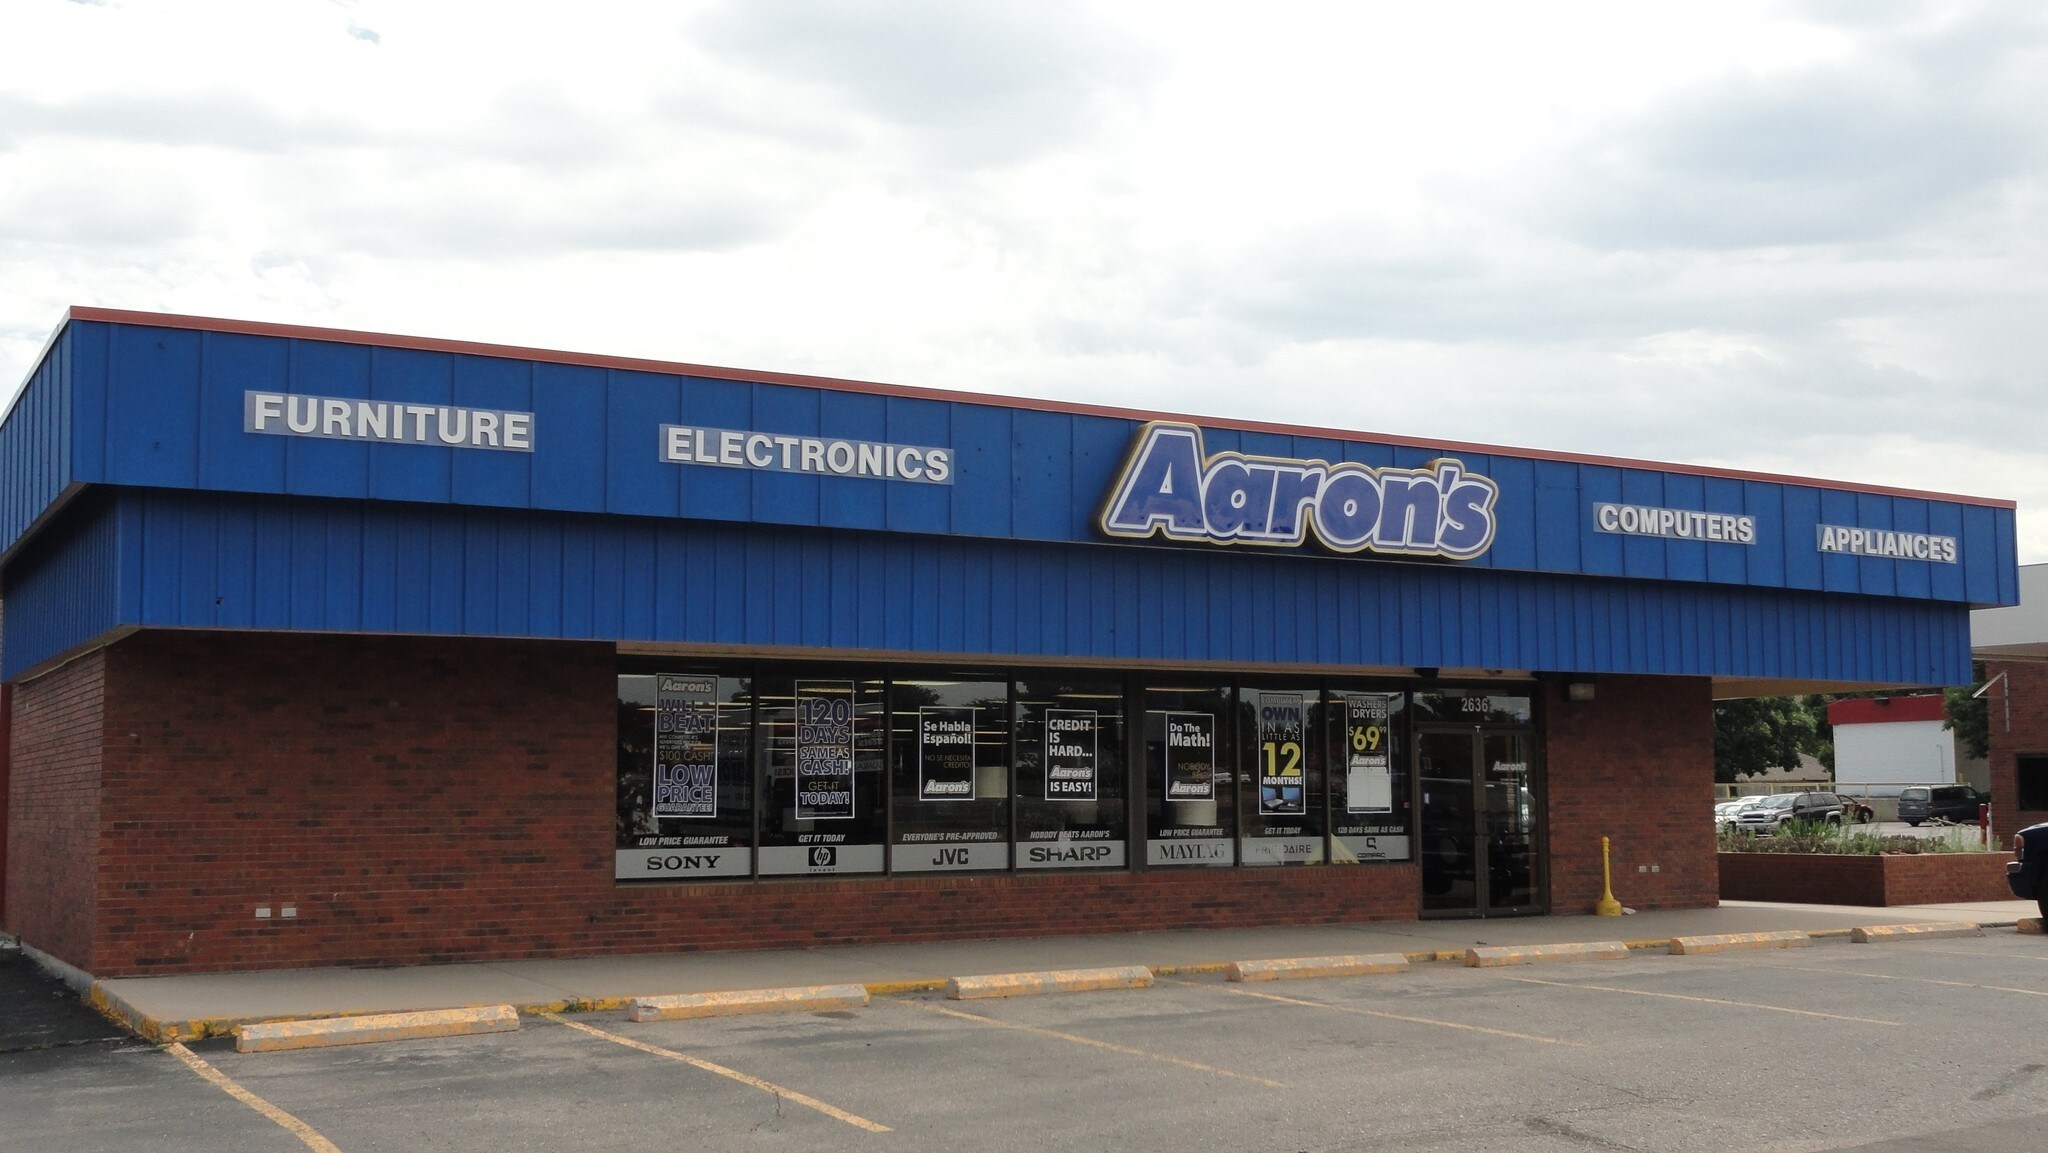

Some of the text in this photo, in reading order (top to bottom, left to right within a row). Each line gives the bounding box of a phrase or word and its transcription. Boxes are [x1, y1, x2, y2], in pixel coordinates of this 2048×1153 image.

[254, 394, 531, 449] FURNITURE
[667, 428, 949, 482] ELECTRONICS
[1107, 427, 1495, 555] Aaron's
[1599, 505, 1754, 542] COMPUTERS
[1820, 527, 1956, 561] APPLIANCES
[661, 679, 713, 693] Aaron's
[1348, 700, 1387, 709] WASHERS
[1461, 697, 1489, 712] 2636
[800, 698, 851, 727] 120
[1261, 706, 1300, 720] OWN
[1352, 709, 1387, 718] DRYERS
[659, 712, 715, 733] BEAT
[923, 721, 971, 732] Se Habla
[1049, 719, 1091, 731] CREDIT
[1169, 723, 1200, 732] Do The
[1261, 722, 1300, 733] IN AS
[800, 726, 850, 744] DAYS
[1049, 732, 1060, 743] IS
[1169, 733, 1211, 747] Math!
[660, 751, 681, 760] $100
[800, 746, 850, 759] SAME AS
[1049, 745, 1093, 757] HARD...
[1262, 742, 1301, 776] 12
[800, 760, 850, 776] CASH!
[1050, 765, 1092, 779] Aaron's
[1177, 763, 1210, 771] NOBODY
[658, 764, 714, 786] LOW
[1263, 777, 1303, 785] MONTHS!
[808, 781, 829, 791] GET
[924, 780, 971, 793] Aaron's
[1050, 782, 1092, 792] IS EASY!
[1170, 781, 1211, 794] Aaron's
[657, 785, 713, 803] PRICE
[800, 791, 850, 805] TODAY!
[657, 803, 713, 813] GUARANTEE!
[798, 834, 846, 843] GET IT TODAY
[903, 832, 998, 842] EVERYONE'S PRE-APPROVED
[1030, 831, 1058, 839] NOBODY
[1080, 830, 1111, 838] AARON'S
[1160, 828, 1224, 837] LOW PRICE GUARANTEE
[639, 836, 729, 846] LOW PRICE GUARANTEE
[1029, 846, 1112, 862] SHARP
[1255, 844, 1312, 854] FRIDAIRE
[646, 855, 721, 871] SONY
[932, 848, 969, 866] JVC
